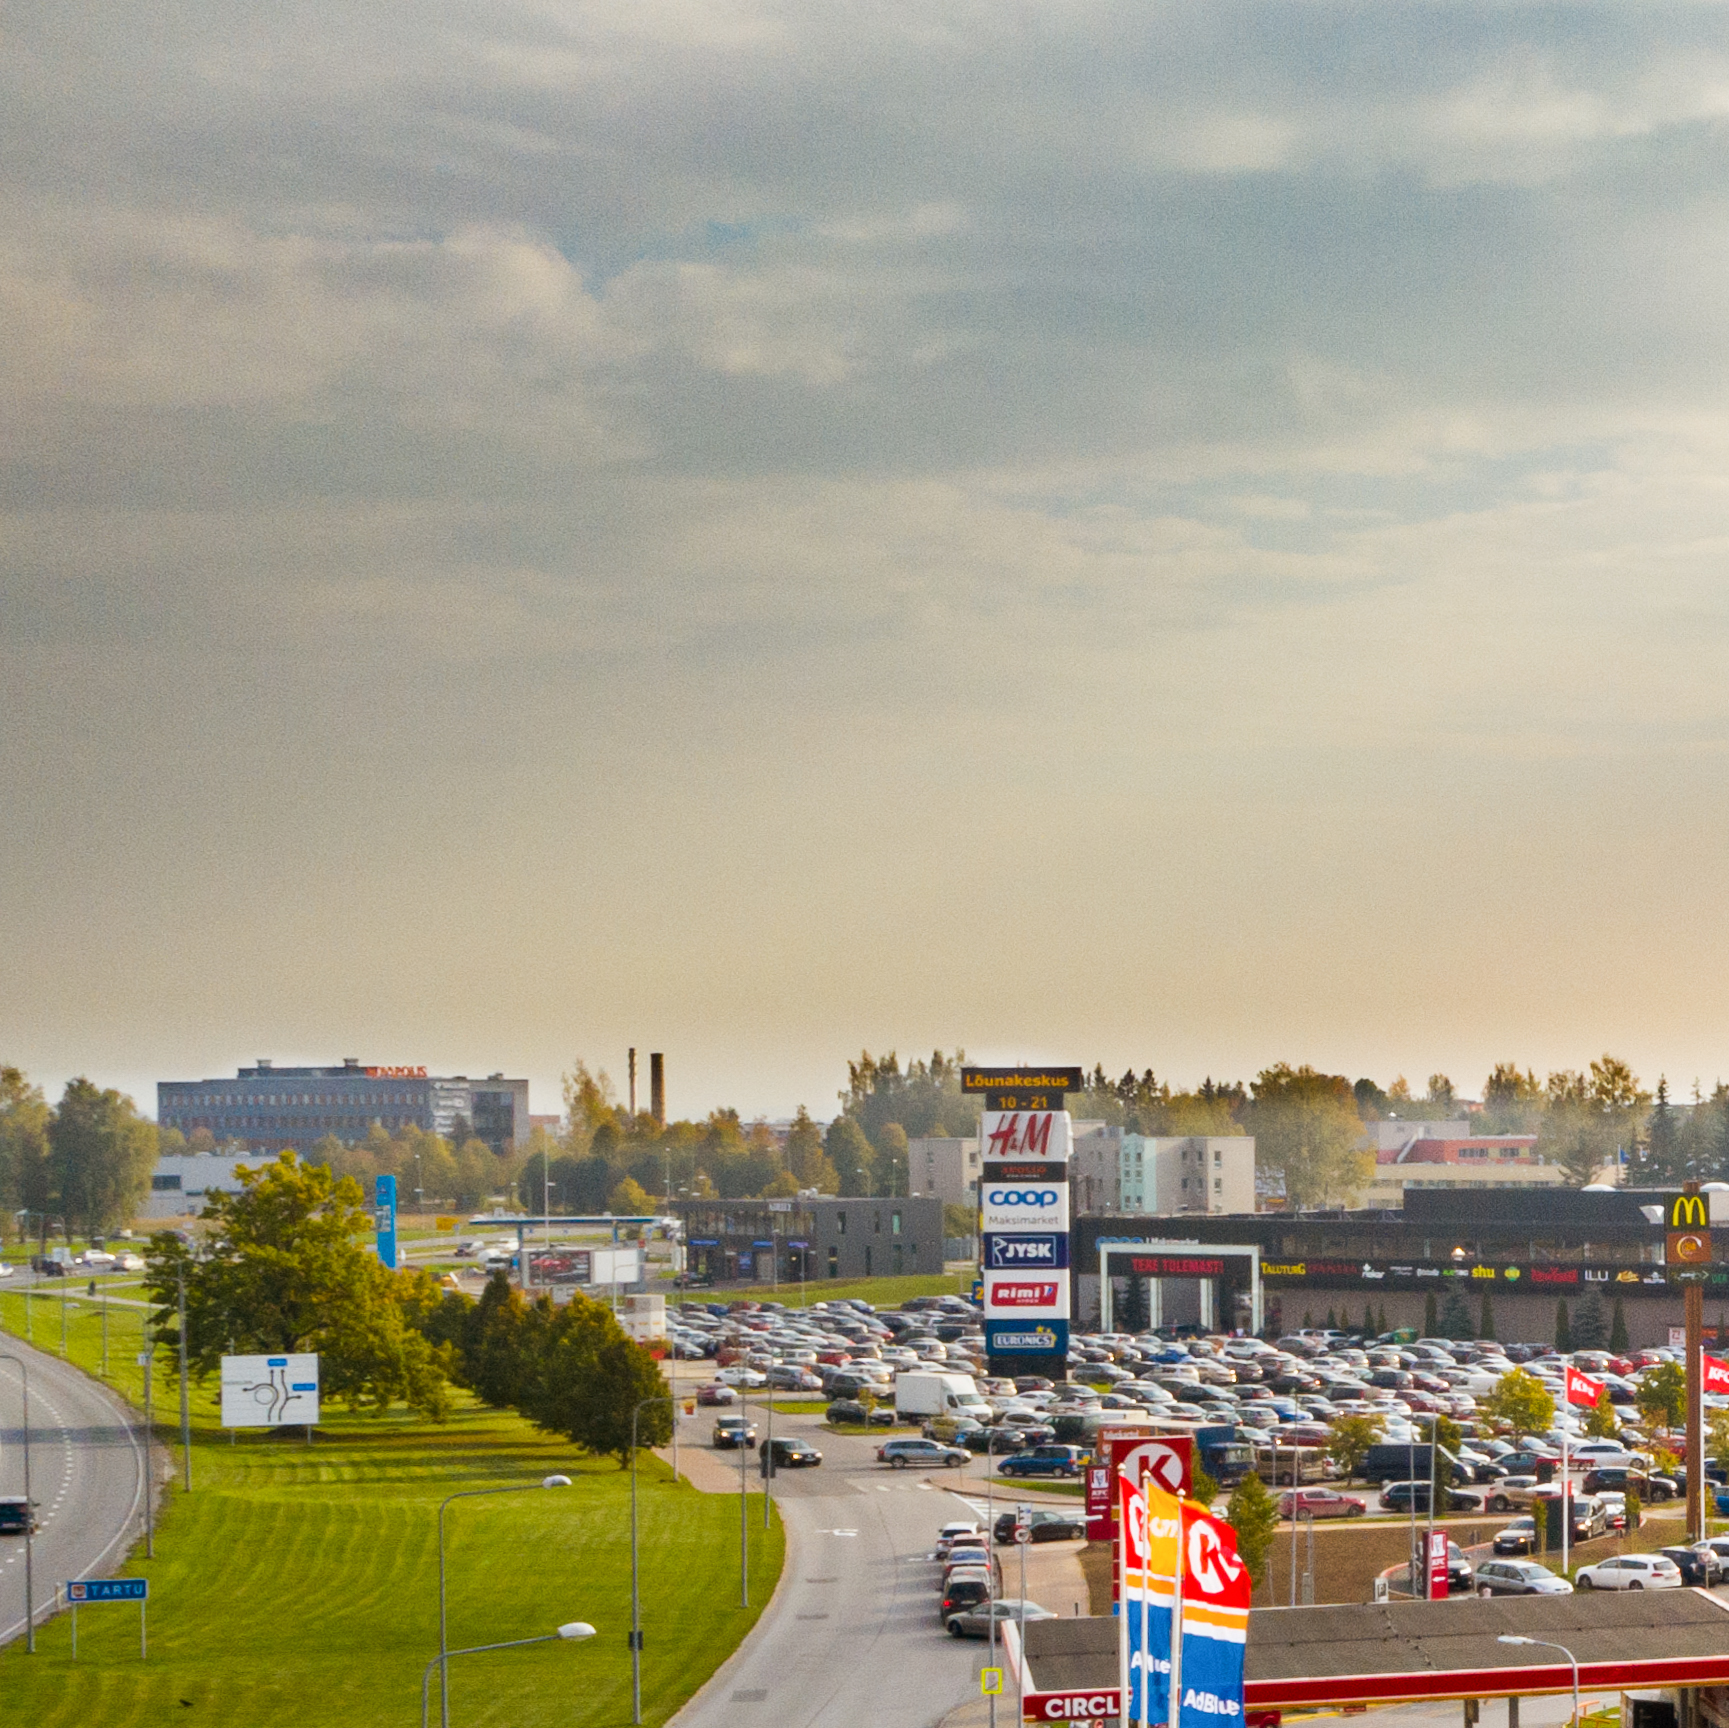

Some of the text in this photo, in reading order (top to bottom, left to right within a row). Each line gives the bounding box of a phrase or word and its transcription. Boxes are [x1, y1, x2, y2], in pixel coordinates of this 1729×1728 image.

[965, 1074, 1069, 1087] Lõunakeskus
[999, 1096, 1017, 1109] 10
[1031, 1096, 1048, 1109] 21
[988, 1112, 1053, 1156] H&M
[988, 1190, 1058, 1208] coop
[988, 1215, 1059, 1226] Maksimarket
[1005, 1243, 1052, 1258] JYSK
[1471, 1264, 1496, 1279] shu
[1585, 1269, 1609, 1281] ILU
[997, 1335, 1050, 1345] EURONICS
[91, 1584, 143, 1596] TARTU
[1045, 1696, 1131, 1720] CIRCL
[1183, 1688, 1241, 1717] AdBlue
